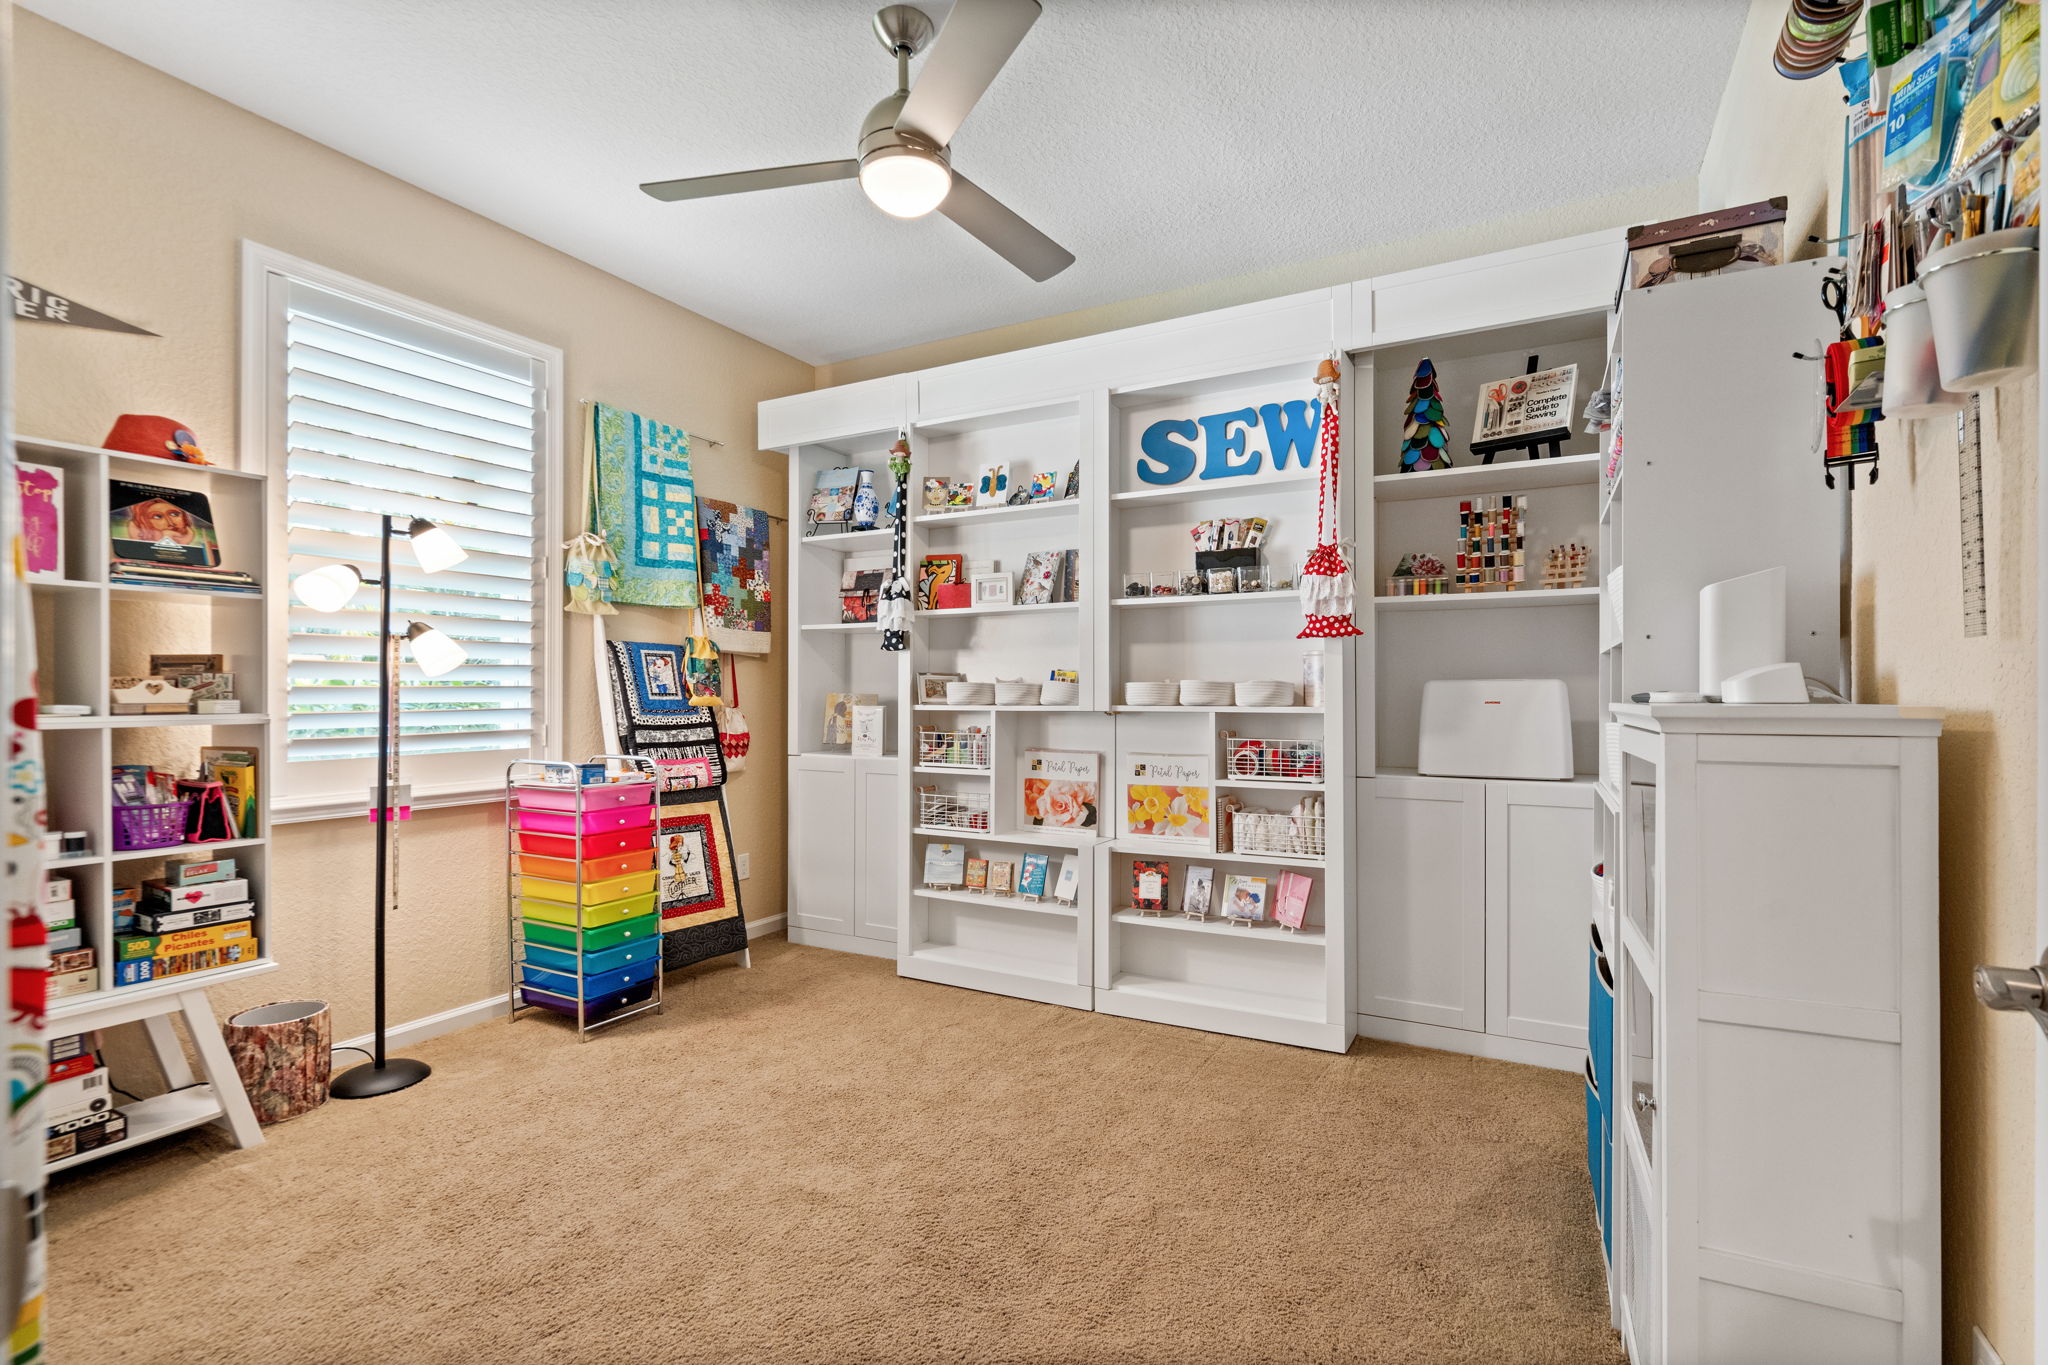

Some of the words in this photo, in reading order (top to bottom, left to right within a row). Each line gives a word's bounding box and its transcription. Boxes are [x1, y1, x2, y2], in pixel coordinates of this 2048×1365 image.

[1889, 113, 1905, 134] 10
[1527, 393, 1568, 407] Complete
[1525, 410, 1557, 421] Sewing
[1526, 404, 1550, 414] Guide
[1137, 398, 1322, 485] SEW
[1046, 760, 1066, 773] Petal
[1068, 761, 1090, 776] Paper
[1150, 765, 1173, 779] Petal
[1175, 765, 1200, 782] Paper
[171, 931, 209, 942] Chiles
[127, 940, 151, 952] 500
[164, 939, 216, 952] Picantes
[140, 961, 151, 980] 1000
[54, 1111, 111, 1134] 1000
